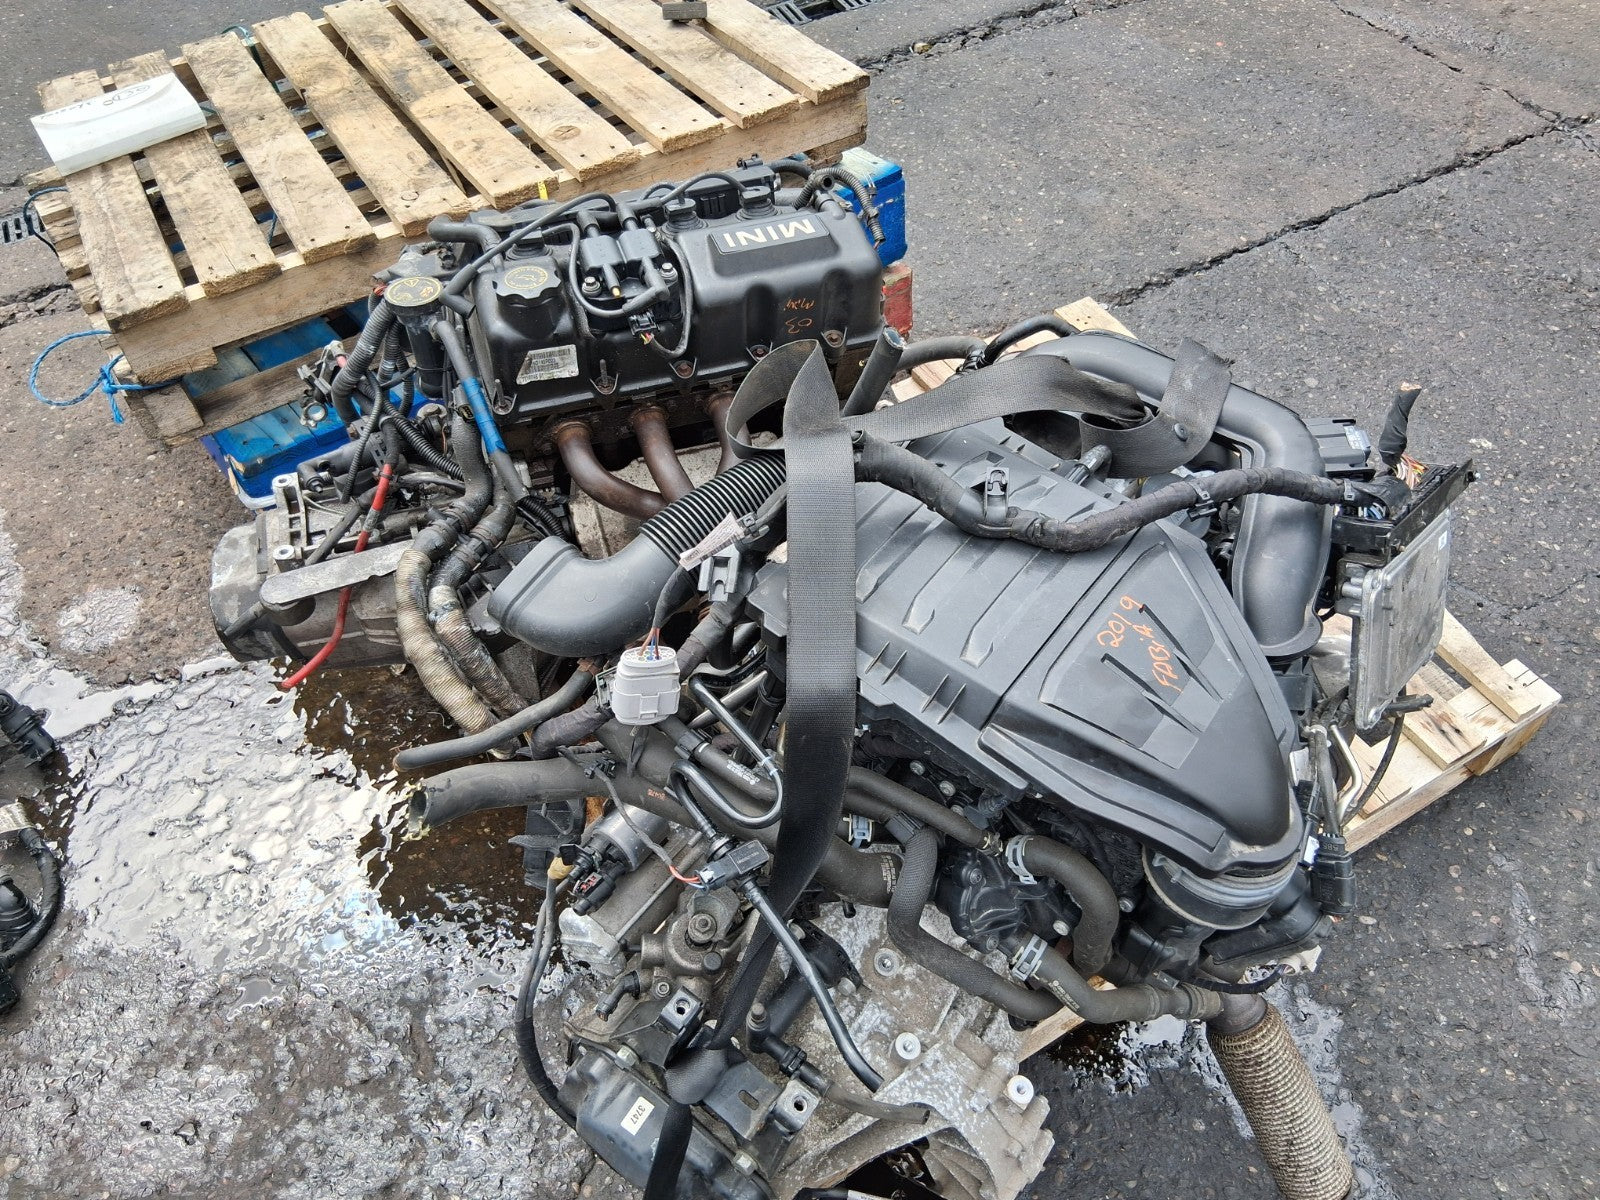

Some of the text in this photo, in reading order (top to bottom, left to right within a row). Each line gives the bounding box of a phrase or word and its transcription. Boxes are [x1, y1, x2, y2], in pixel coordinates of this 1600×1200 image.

[723, 219, 816, 248] MINI
[785, 317, 813, 334] 03
[1097, 596, 1143, 648] 2019
[630, 1105, 646, 1125] 3747
